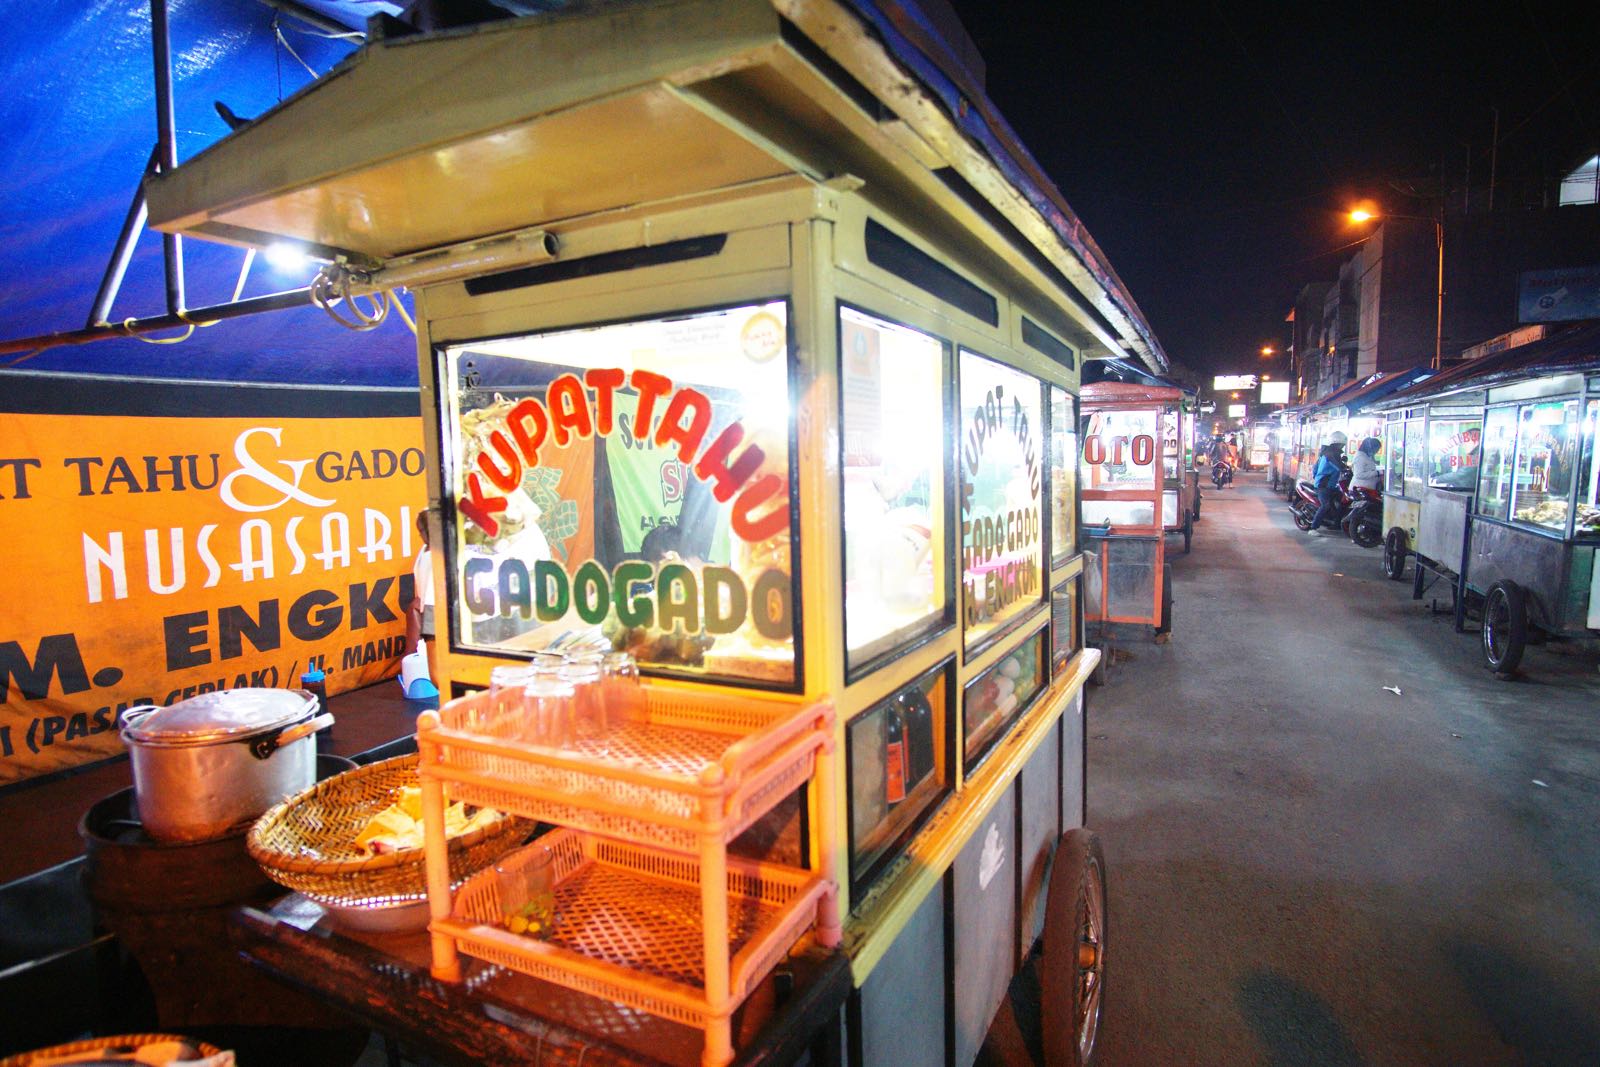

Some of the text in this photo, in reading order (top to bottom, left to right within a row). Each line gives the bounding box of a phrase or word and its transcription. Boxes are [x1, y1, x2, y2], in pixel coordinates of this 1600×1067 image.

[0, 458, 42, 500] T
[64, 453, 220, 497] TAHU
[314, 447, 426, 483] GADO
[82, 506, 412, 604] NUSASARI
[26, 697, 154, 754] (PAS
